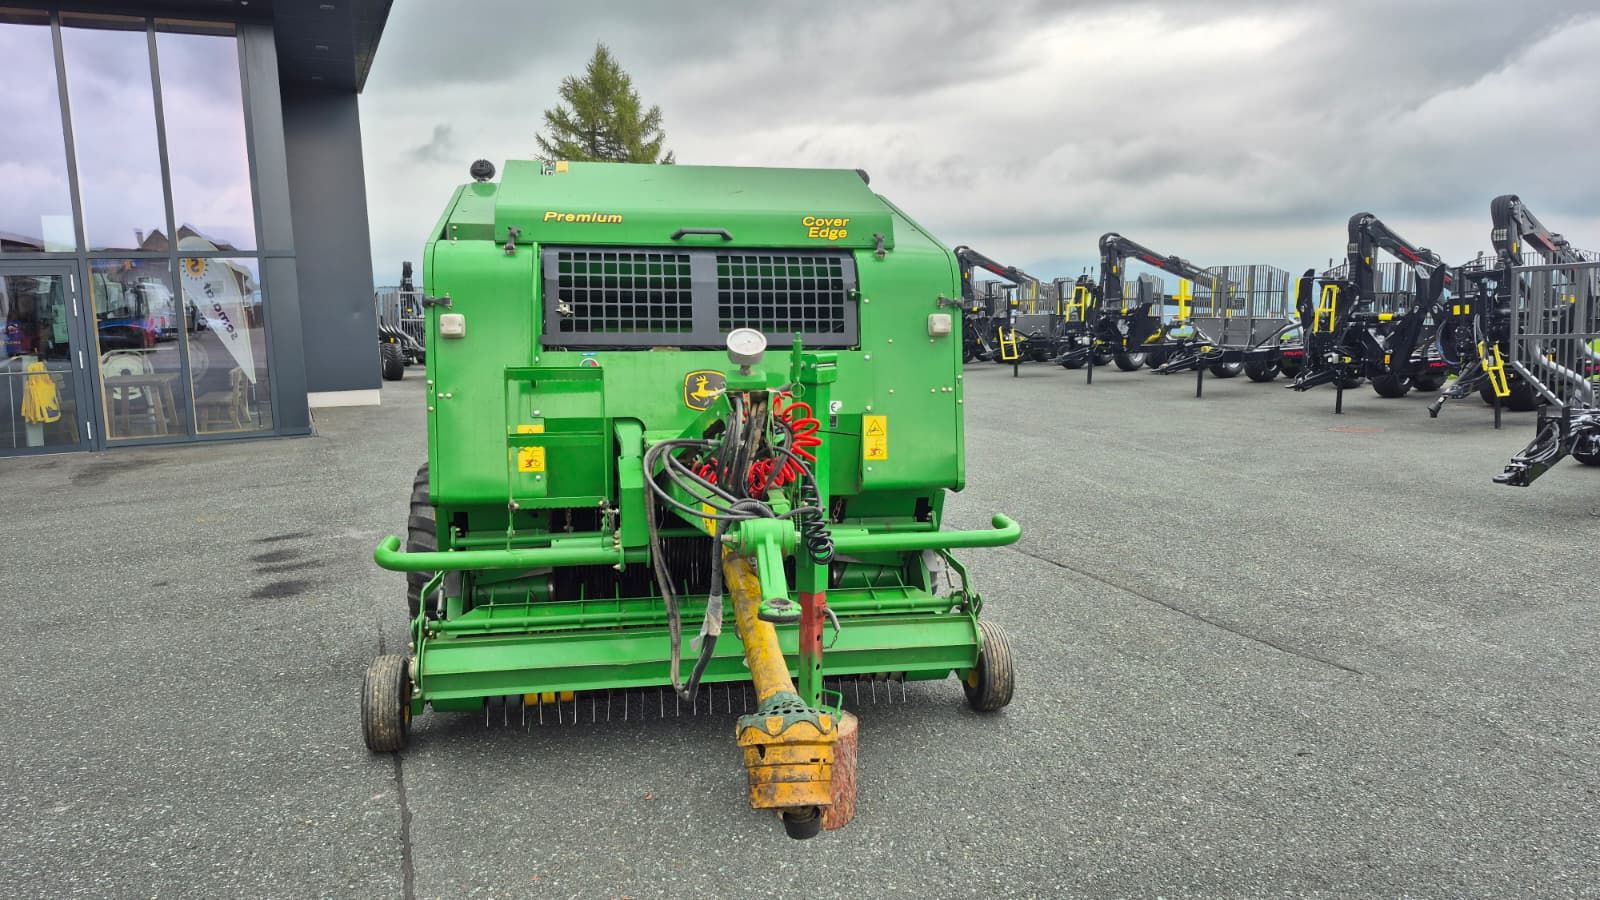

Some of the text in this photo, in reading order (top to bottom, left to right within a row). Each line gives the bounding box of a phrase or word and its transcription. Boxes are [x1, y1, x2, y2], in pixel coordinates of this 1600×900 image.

[543, 211, 623, 223] Premium
[802, 216, 849, 227] Cover
[808, 226, 848, 241] Edge
